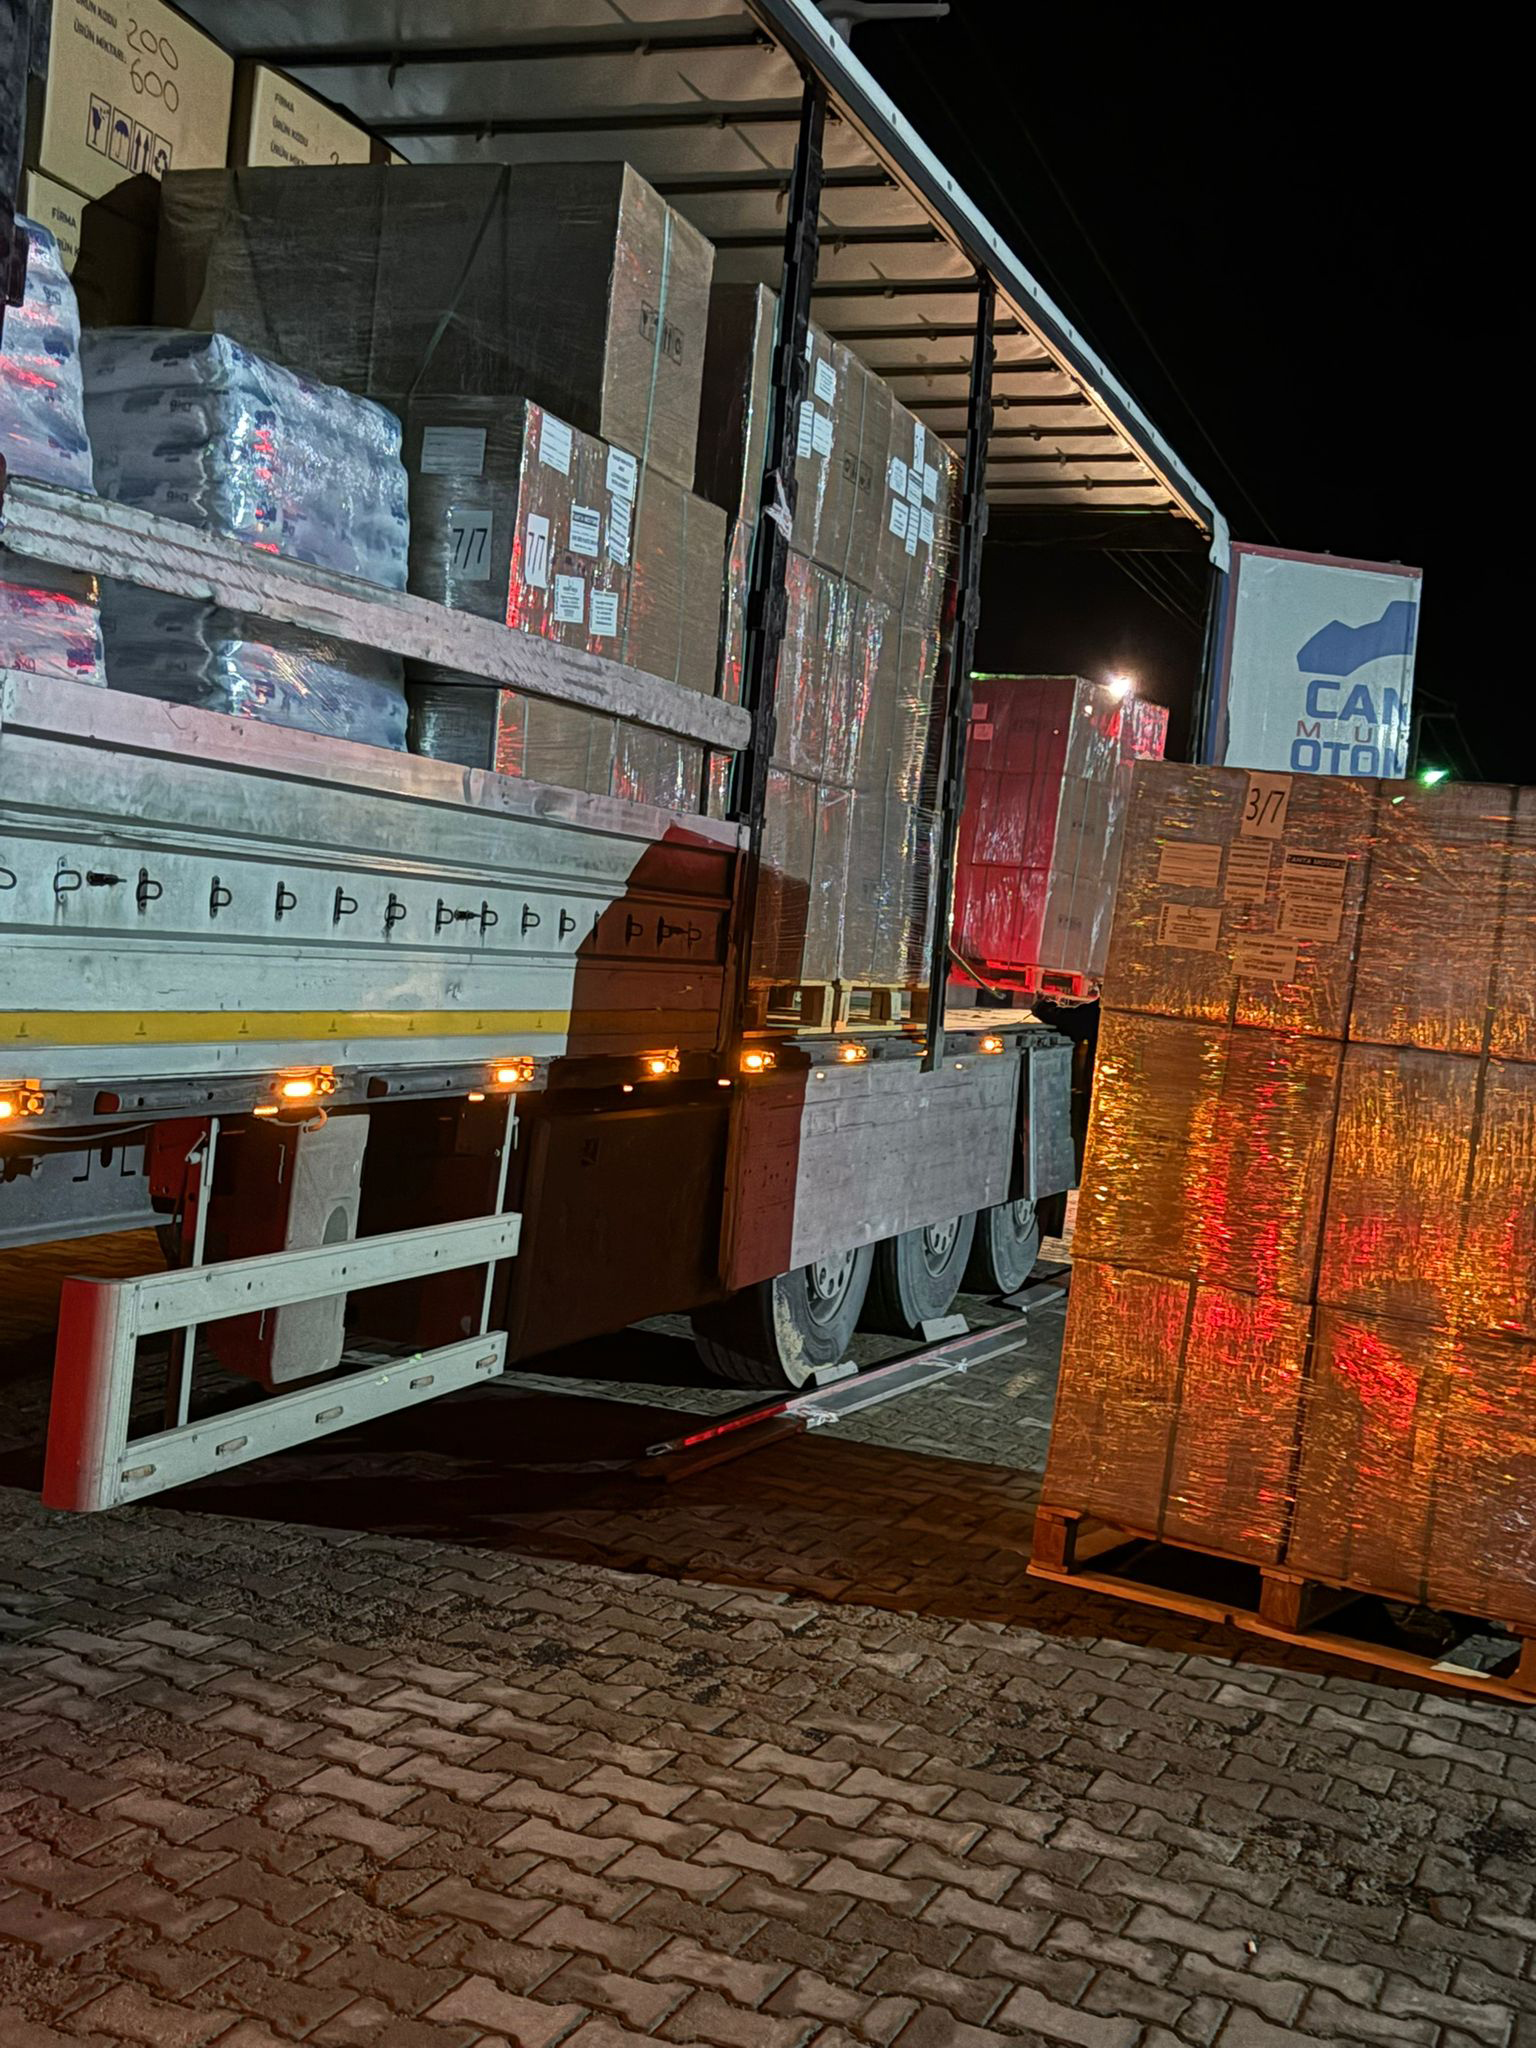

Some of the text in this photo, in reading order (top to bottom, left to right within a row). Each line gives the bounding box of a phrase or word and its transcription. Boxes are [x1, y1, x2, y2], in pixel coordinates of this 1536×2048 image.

[127, 18, 179, 70] 200
[130, 58, 179, 113] 600
[52, 207, 77, 229] FİRMA
[453, 528, 488, 570] 7/7
[527, 531, 546, 575] 7/7
[1246, 788, 1285, 827] 3/7
